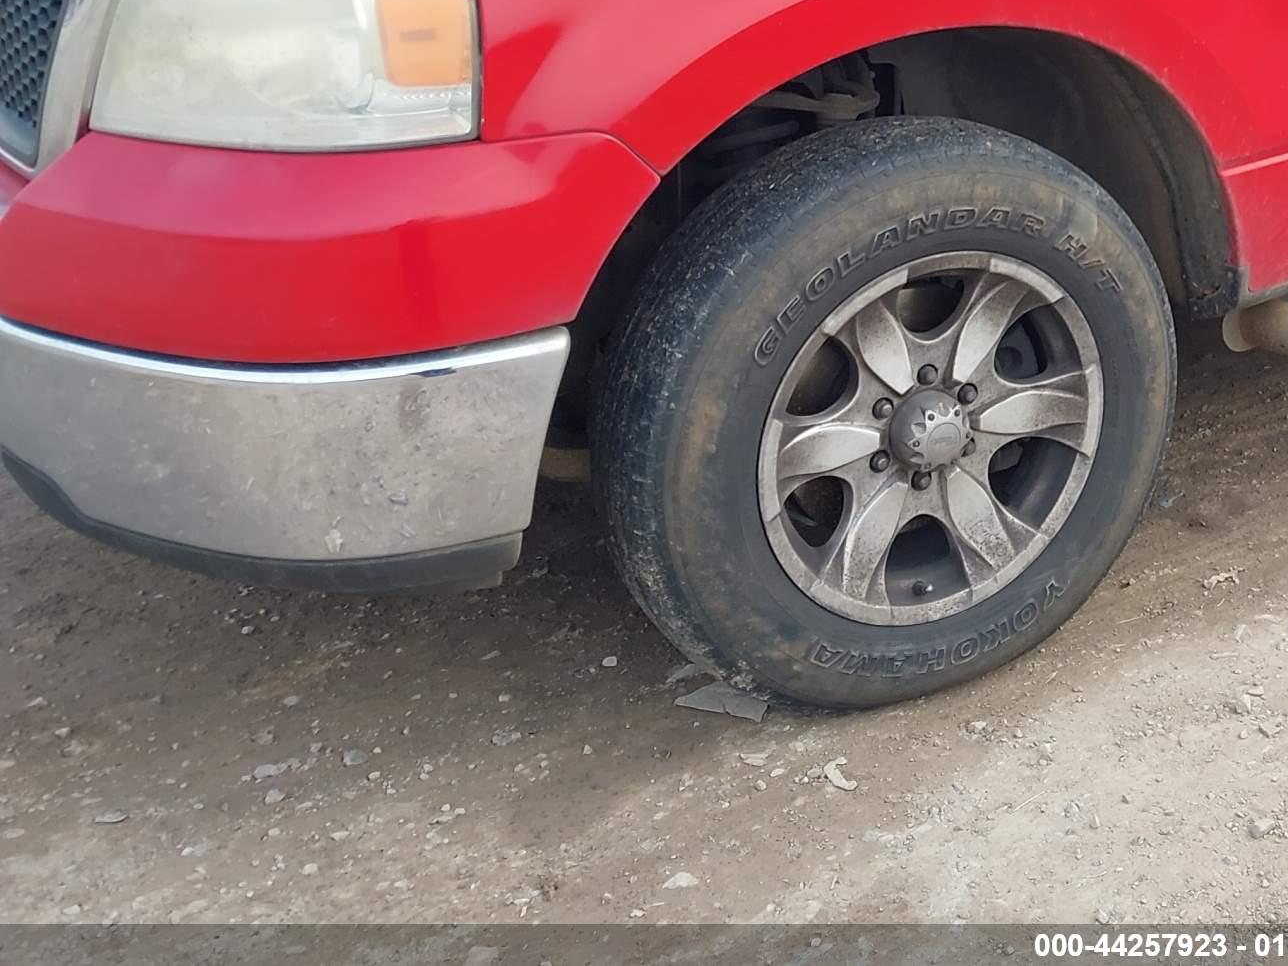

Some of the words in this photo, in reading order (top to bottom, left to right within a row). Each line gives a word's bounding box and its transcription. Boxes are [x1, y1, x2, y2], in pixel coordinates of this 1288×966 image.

[754, 206, 1047, 366] GEOLANDAR
[1054, 233, 1123, 293] H/T
[809, 580, 1066, 678] YOKOHAMA
